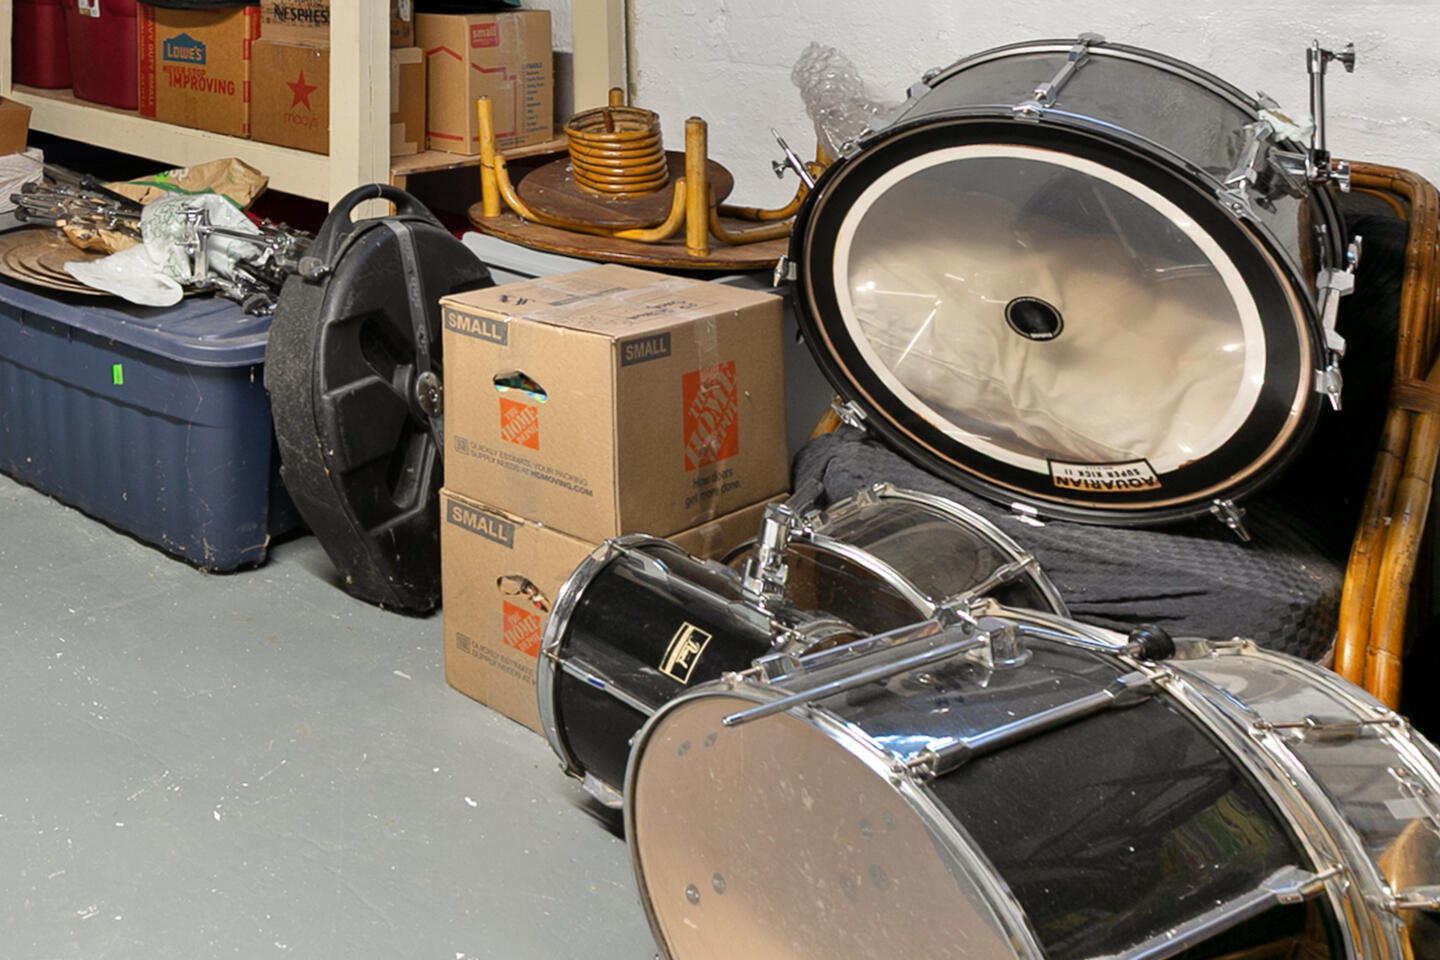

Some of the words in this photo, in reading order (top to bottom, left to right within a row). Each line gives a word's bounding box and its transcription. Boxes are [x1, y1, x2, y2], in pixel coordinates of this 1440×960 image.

[273, 2, 330, 24] NESPRES
[167, 43, 203, 61] LOWE'S
[168, 73, 236, 96] IMPROVING
[447, 313, 502, 340] SMALL
[625, 338, 668, 361] SMALL
[503, 407, 538, 441] HOME
[471, 450, 496, 464] SUPPLY
[533, 462, 554, 476] YOUR
[1078, 470, 1102, 478] KICK
[1107, 468, 1141, 477] SUPER
[1055, 476, 1155, 490] AQUARIAN
[452, 506, 508, 541] SMALL
